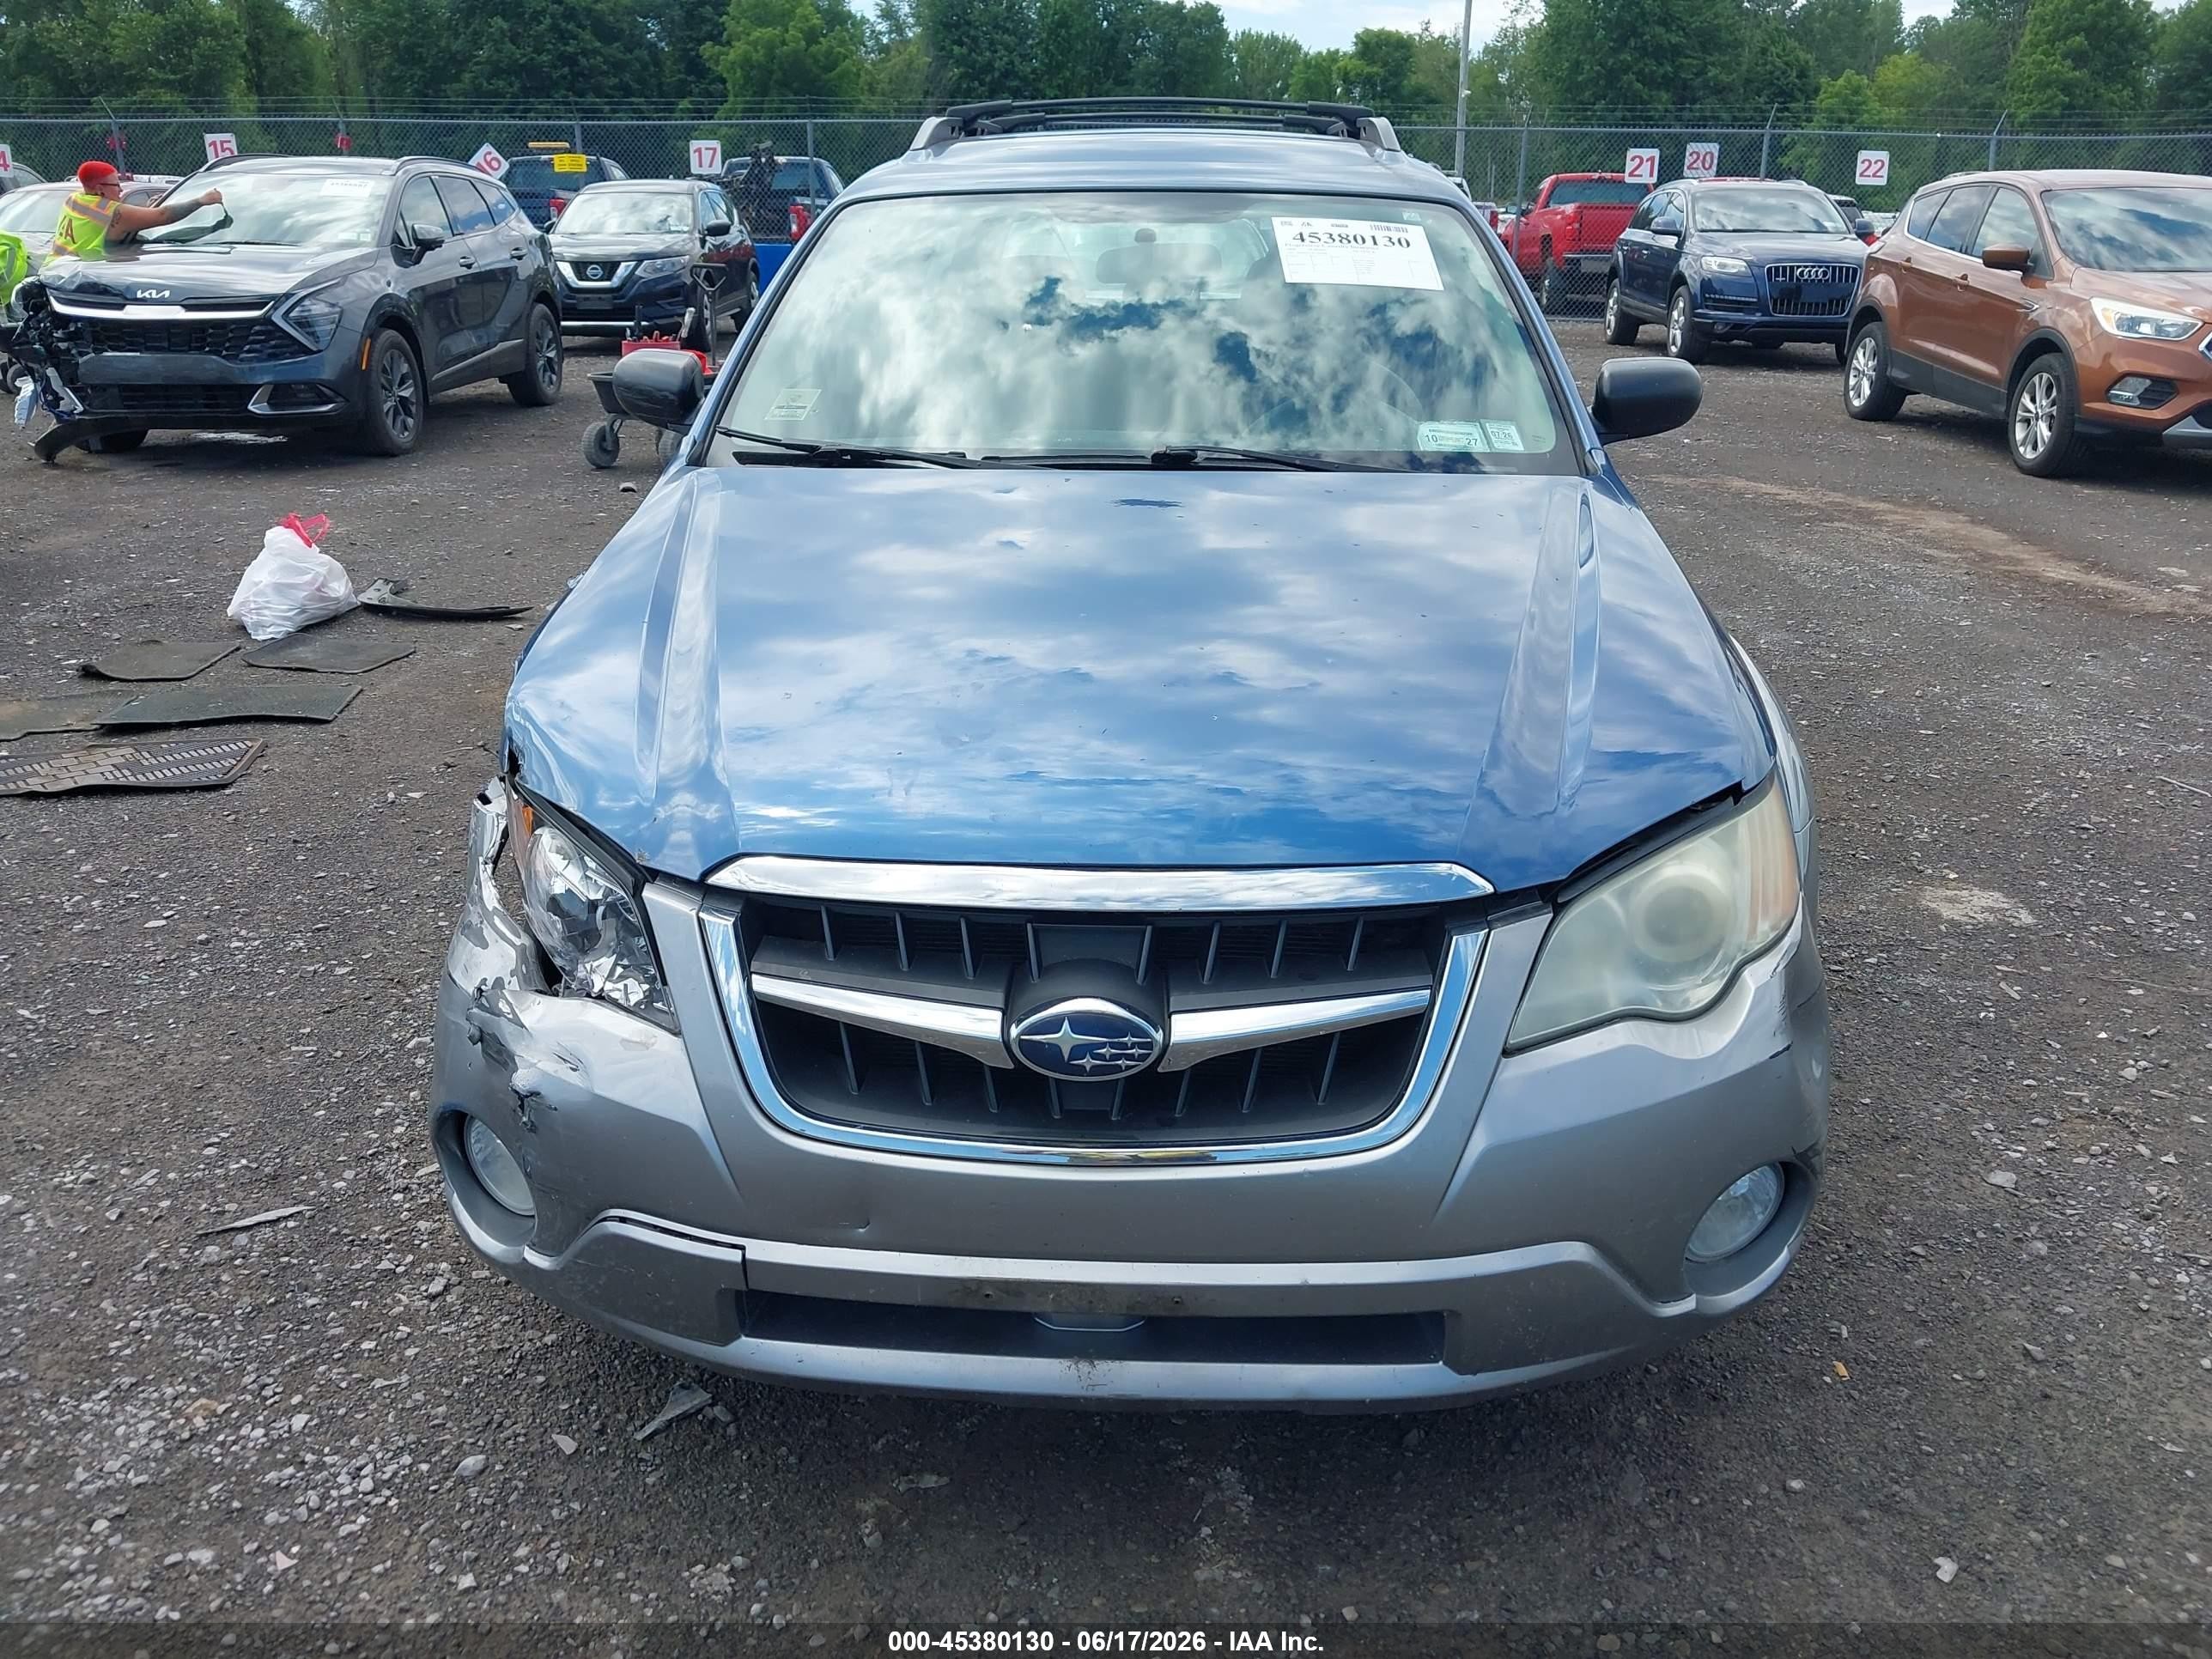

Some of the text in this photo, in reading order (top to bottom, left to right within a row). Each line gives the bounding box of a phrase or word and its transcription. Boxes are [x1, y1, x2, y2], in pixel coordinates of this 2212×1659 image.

[208, 139, 234, 159] 15
[693, 147, 717, 168] 17
[1628, 155, 1656, 178] 21
[1686, 150, 1715, 171] 20
[1859, 158, 1885, 178] 22
[1292, 231, 1411, 249] 45380130
[1425, 434, 1438, 443] 10
[1465, 438, 1478, 447] 27
